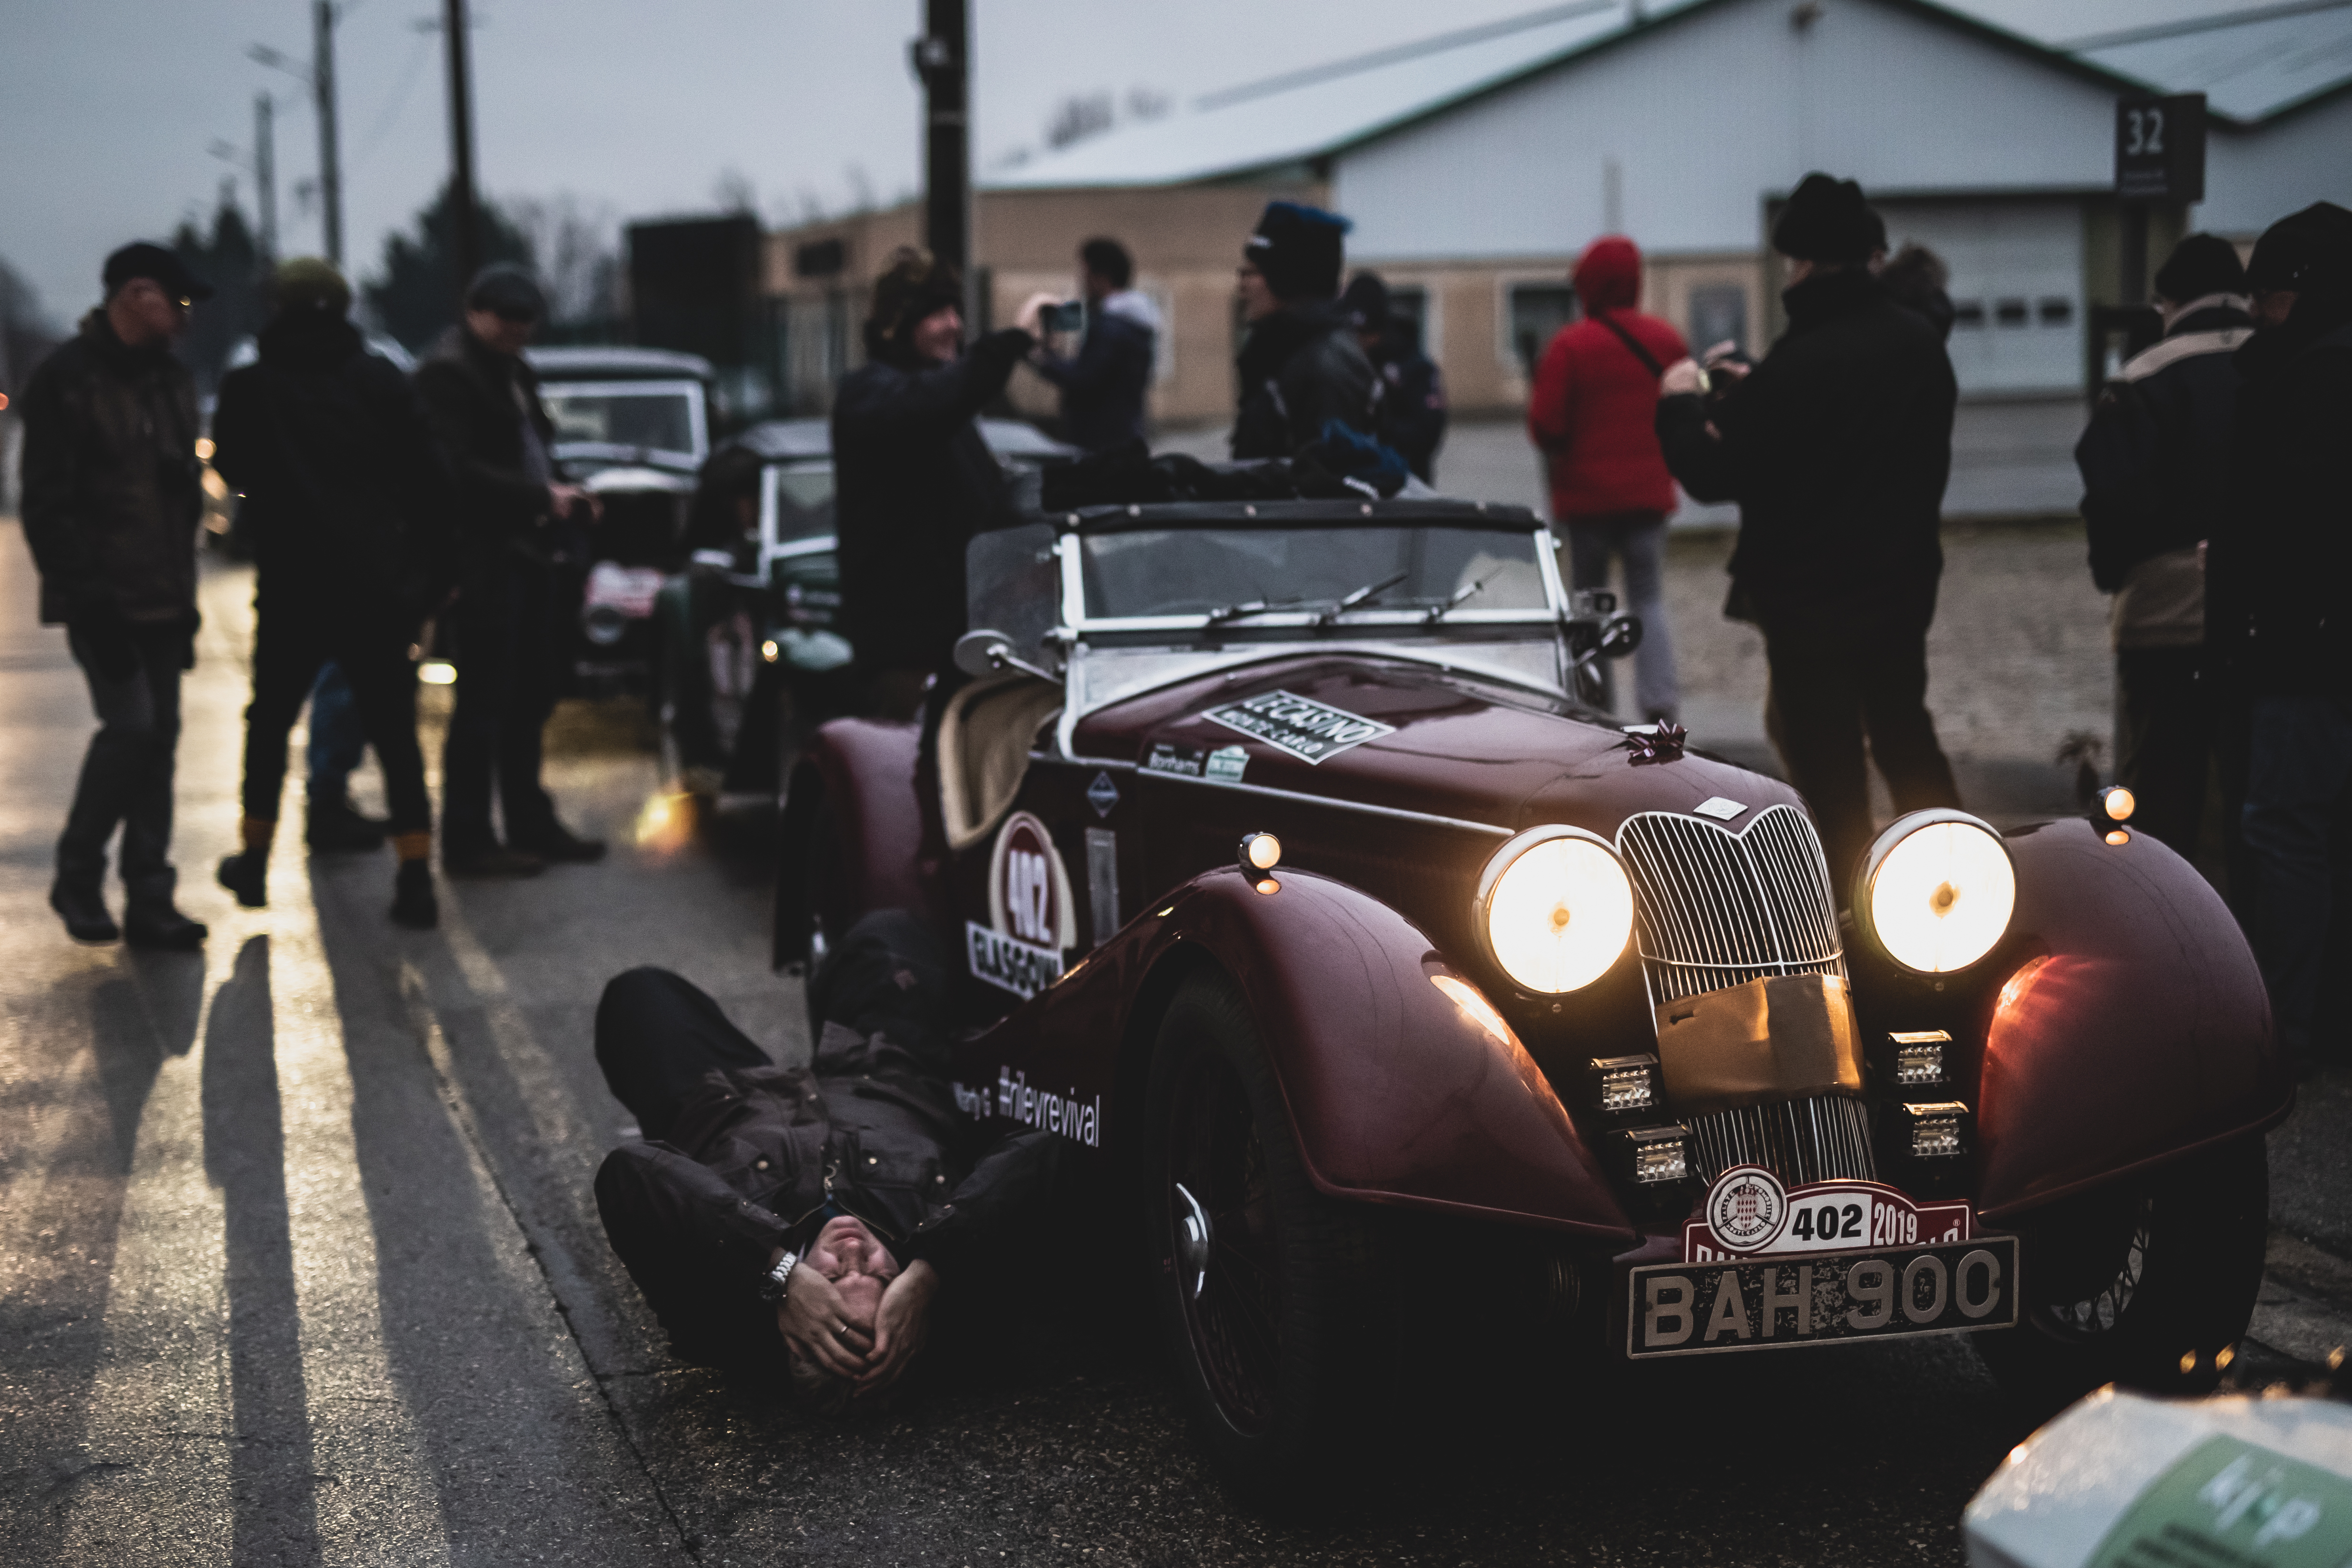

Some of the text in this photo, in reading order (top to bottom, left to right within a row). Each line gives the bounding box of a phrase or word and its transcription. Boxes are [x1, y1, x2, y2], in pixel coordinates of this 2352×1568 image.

[2125, 106, 2164, 156] 32
[1269, 703, 1375, 743] CASINO
[1008, 850, 1050, 942] 402
[1792, 1203, 1863, 1242] 402
[1873, 1202, 1917, 1246] 2019
[1645, 1250, 2000, 1347] BAH 900
